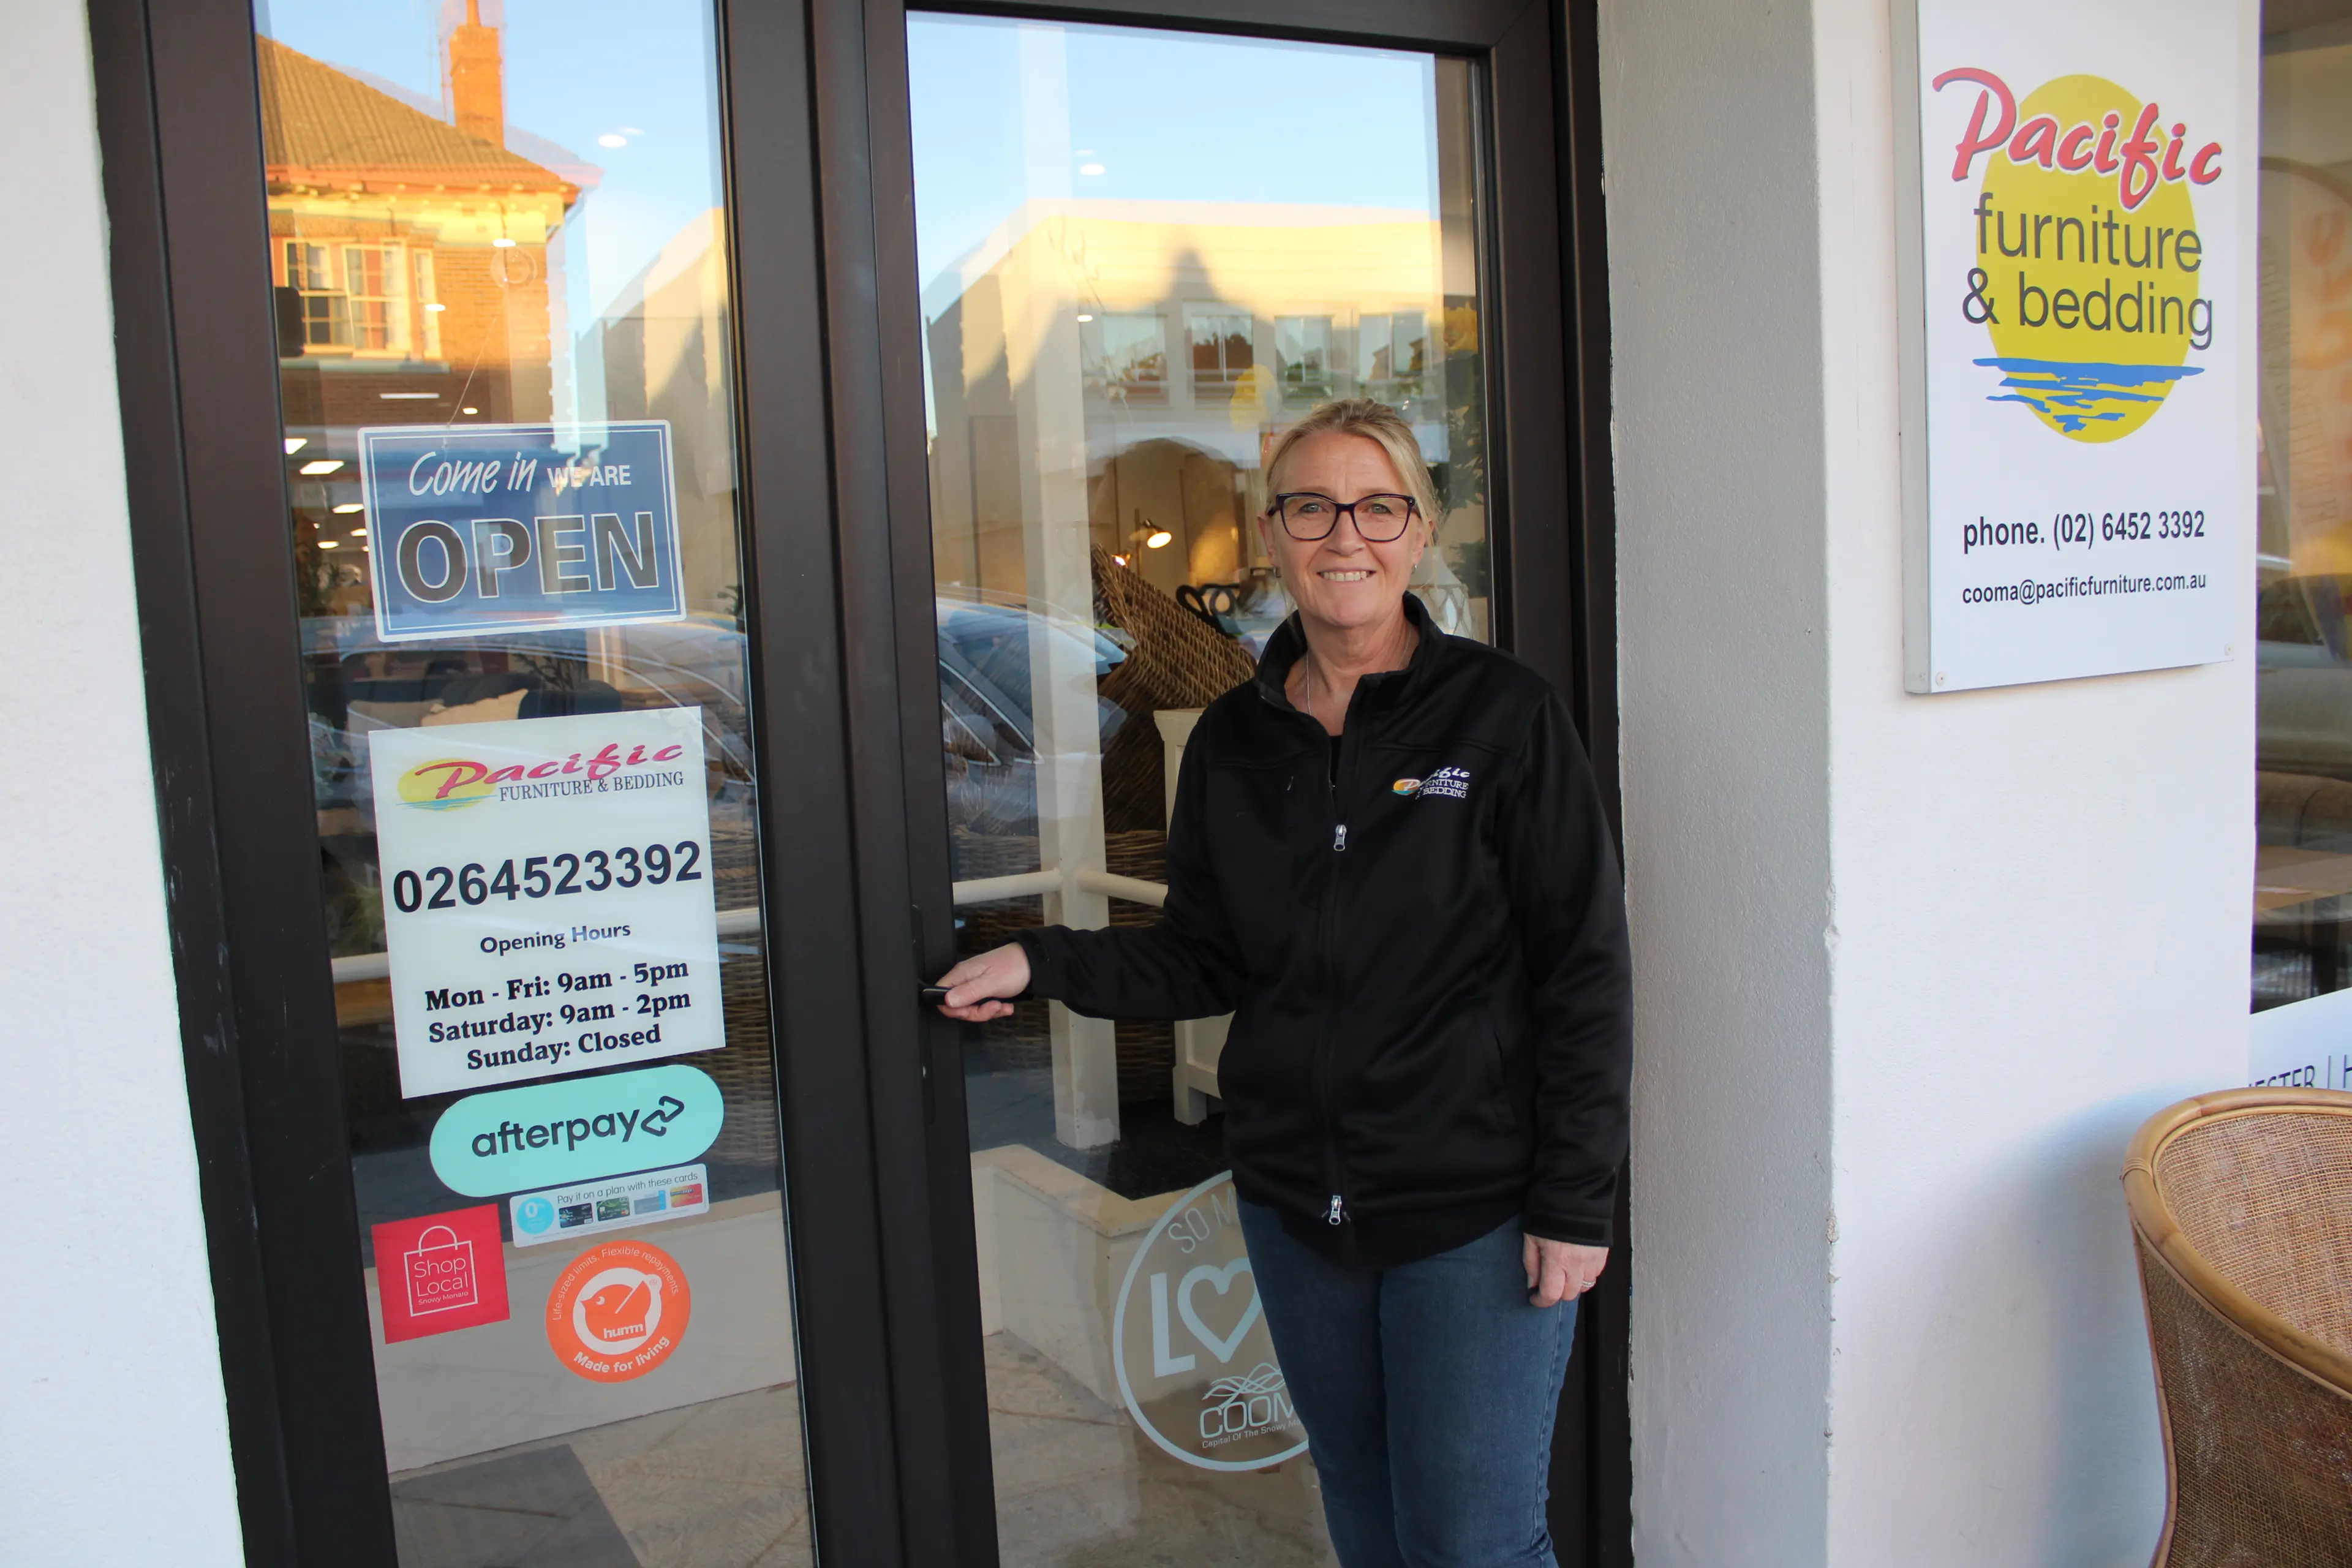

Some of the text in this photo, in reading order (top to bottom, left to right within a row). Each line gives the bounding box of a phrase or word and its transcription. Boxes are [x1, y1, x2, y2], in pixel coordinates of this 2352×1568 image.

[1932, 67, 2222, 211] Pacific
[1973, 192, 2202, 273] furniture
[1962, 267, 2213, 351] & bedding
[409, 451, 632, 496] Come in WE ARE
[1963, 510, 2205, 554] phone. (02) 6452 3392
[396, 511, 660, 603] OPEN
[1962, 573, 2206, 605] cooma@pacificfurniture.com.au
[415, 743, 684, 799] Pacific
[499, 771, 685, 802] FURNITURE & BEDDING
[393, 840, 703, 913] 0264523392
[480, 924, 631, 956] Opening Hours
[425, 988, 485, 1012] Mon
[507, 975, 551, 1001] Fri:
[557, 969, 613, 993] 9am
[634, 960, 690, 987] 5pm
[429, 1011, 554, 1043] Saturday:
[559, 1000, 615, 1025] 9am
[636, 991, 692, 1017] 2pm
[467, 1023, 662, 1071] Sunday: Closed
[472, 1109, 640, 1158] afterpay
[557, 1194, 574, 1204] Pay
[576, 1191, 581, 1200] it
[606, 1185, 625, 1197] plan
[627, 1181, 646, 1191] with
[648, 1177, 672, 1188] these
[674, 1171, 698, 1183] cards
[1168, 1207, 1210, 1253] SO
[414, 1257, 466, 1281] Shop
[416, 1272, 469, 1297] Local
[553, 1273, 575, 1321] Life-sized
[601, 1246, 639, 1258] Flexible
[418, 1291, 469, 1305] Snowy Monaro
[603, 1323, 644, 1339] humm
[573, 1336, 671, 1373] Made for living
[1202, 1435, 1231, 1449] Capital
[1244, 1428, 1259, 1439] The
[1261, 1422, 1286, 1434] Snowy
